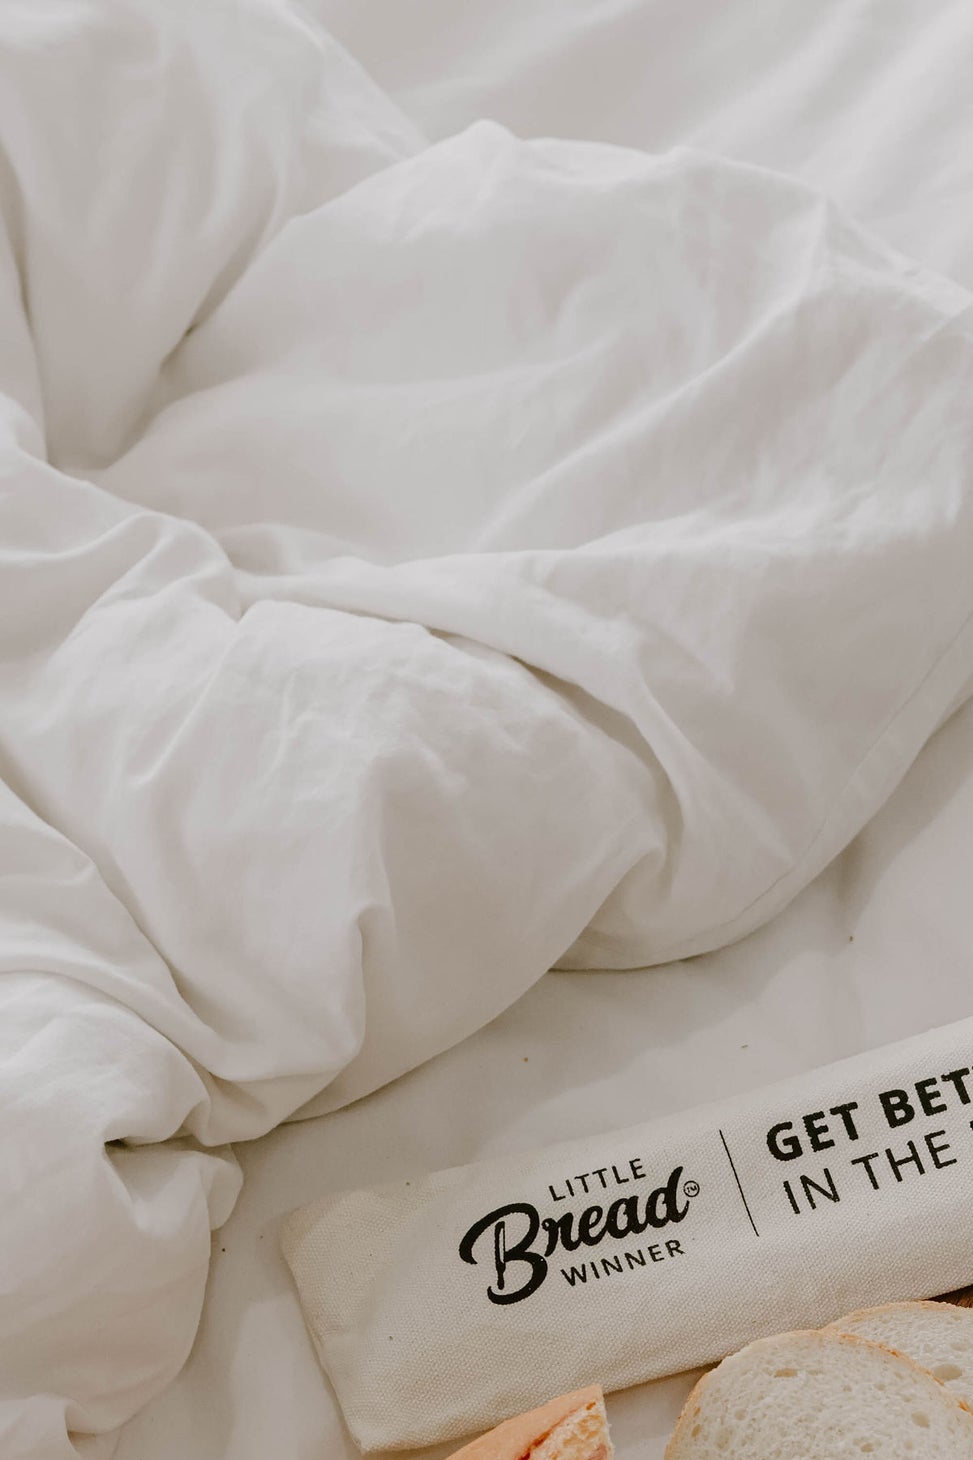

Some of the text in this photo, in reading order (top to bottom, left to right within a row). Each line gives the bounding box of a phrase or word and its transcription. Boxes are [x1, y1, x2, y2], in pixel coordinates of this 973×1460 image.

[765, 1101, 859, 1162] GET
[548, 1158, 647, 1202] LITTLE
[782, 1167, 841, 1215] IN
[850, 1129, 958, 1191] THE
[458, 1165, 690, 1306] Bread
[559, 1239, 686, 1287] WINNER
